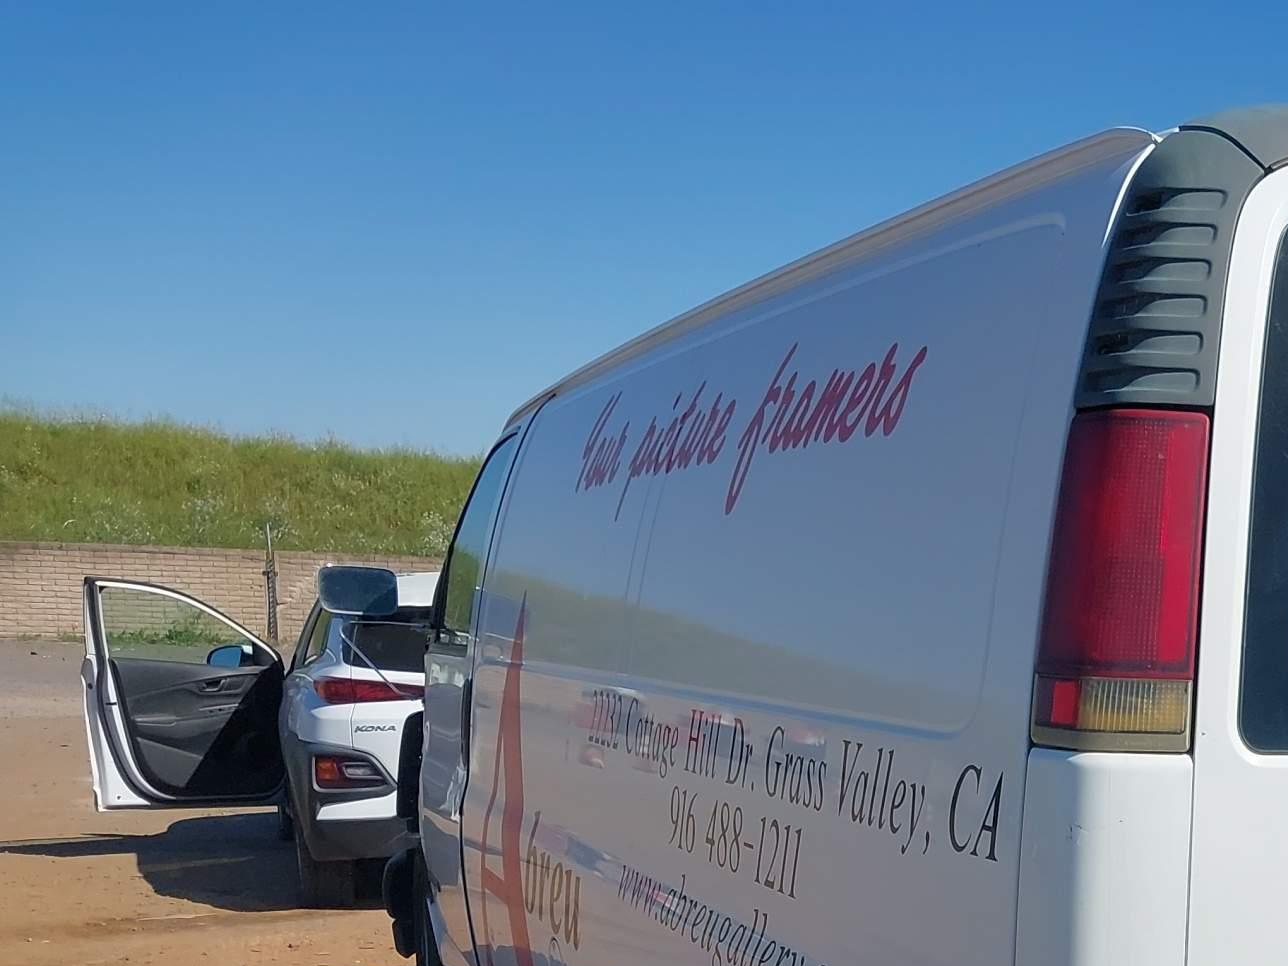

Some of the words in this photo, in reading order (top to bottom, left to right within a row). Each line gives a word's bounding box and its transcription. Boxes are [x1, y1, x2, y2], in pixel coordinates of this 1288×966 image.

[575, 390, 630, 493] Your
[615, 380, 737, 522] picture
[724, 341, 928, 516] framers
[354, 725, 396, 733] KONA
[626, 697, 679, 778] Cottage
[684, 709, 722, 779] Hill
[726, 718, 754, 792] Dr.
[765, 726, 827, 812] Grass
[838, 740, 930, 855] Valley,
[949, 764, 1004, 862] CA
[668, 785, 698, 853] 916
[706, 800, 802, 899] 488-1211
